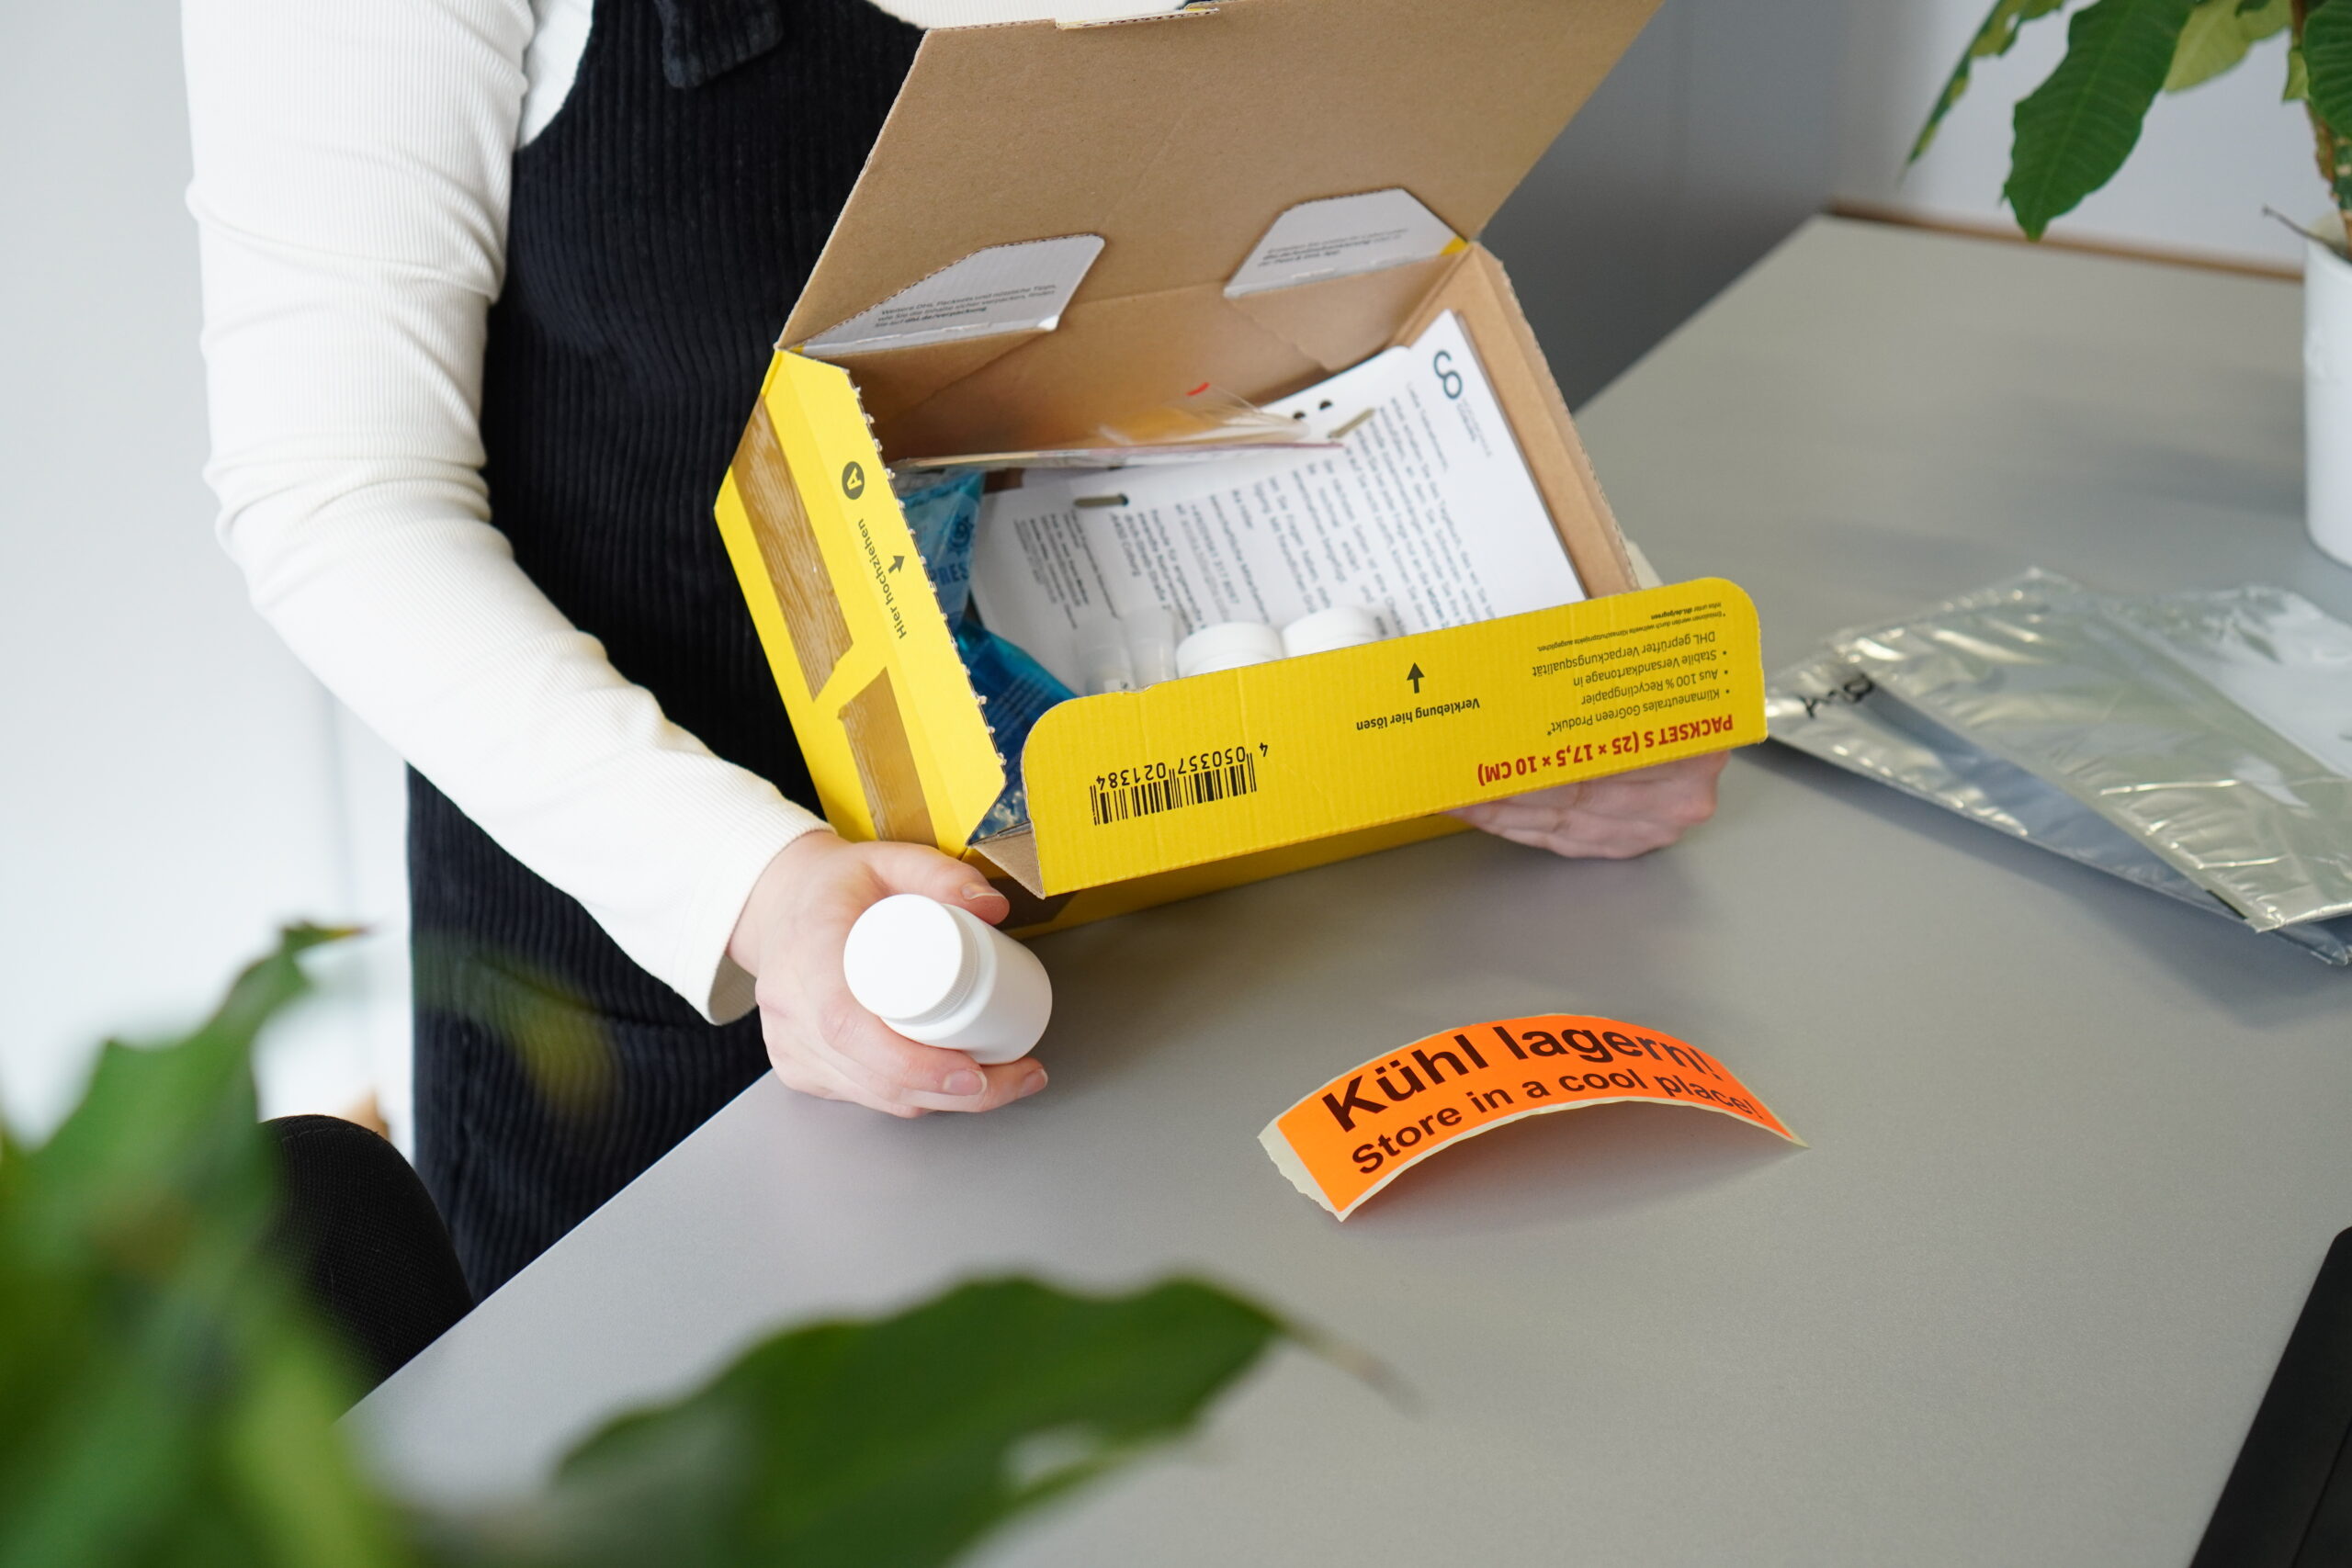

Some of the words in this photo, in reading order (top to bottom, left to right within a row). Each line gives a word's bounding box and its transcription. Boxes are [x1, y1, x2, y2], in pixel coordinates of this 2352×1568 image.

[858, 518, 894, 605] hochziehen
[890, 606, 907, 639] Hier
[1641, 633, 1691, 654] geprüfter
[1692, 630, 1715, 645] DHL
[1532, 647, 1640, 677] Verpackungsqualität
[1681, 649, 1717, 666] Stabile
[1573, 676, 1584, 688] in
[1585, 657, 1680, 684] Versandkartonage
[1676, 673, 1697, 688] 100
[1699, 669, 1718, 681] Aus
[1581, 680, 1664, 705] Recyclingpapier
[1642, 688, 1720, 712] Klimaneutrales
[1390, 711, 1413, 725] hier
[1415, 698, 1480, 718] Verklebung
[1595, 705, 1641, 722] GoGreen
[1356, 716, 1388, 731] lösen
[1659, 714, 1734, 740] PACKSET
[1611, 731, 1639, 755] (25
[1644, 730, 1655, 749] S
[1178, 746, 1246, 774] 050357
[1515, 756, 1537, 775] 10
[1555, 744, 1593, 767] 17,5
[1096, 761, 1166, 791] 021384
[1477, 761, 1512, 786] CM)
[1322, 1033, 1489, 1133] Kühl
[1492, 1025, 1724, 1081] lagern!
[1351, 1107, 1463, 1174] Store
[1465, 1089, 1514, 1113] in
[1522, 1080, 1552, 1099] a
[1558, 1068, 1649, 1093] cool
[1654, 1075, 1765, 1120] place!
